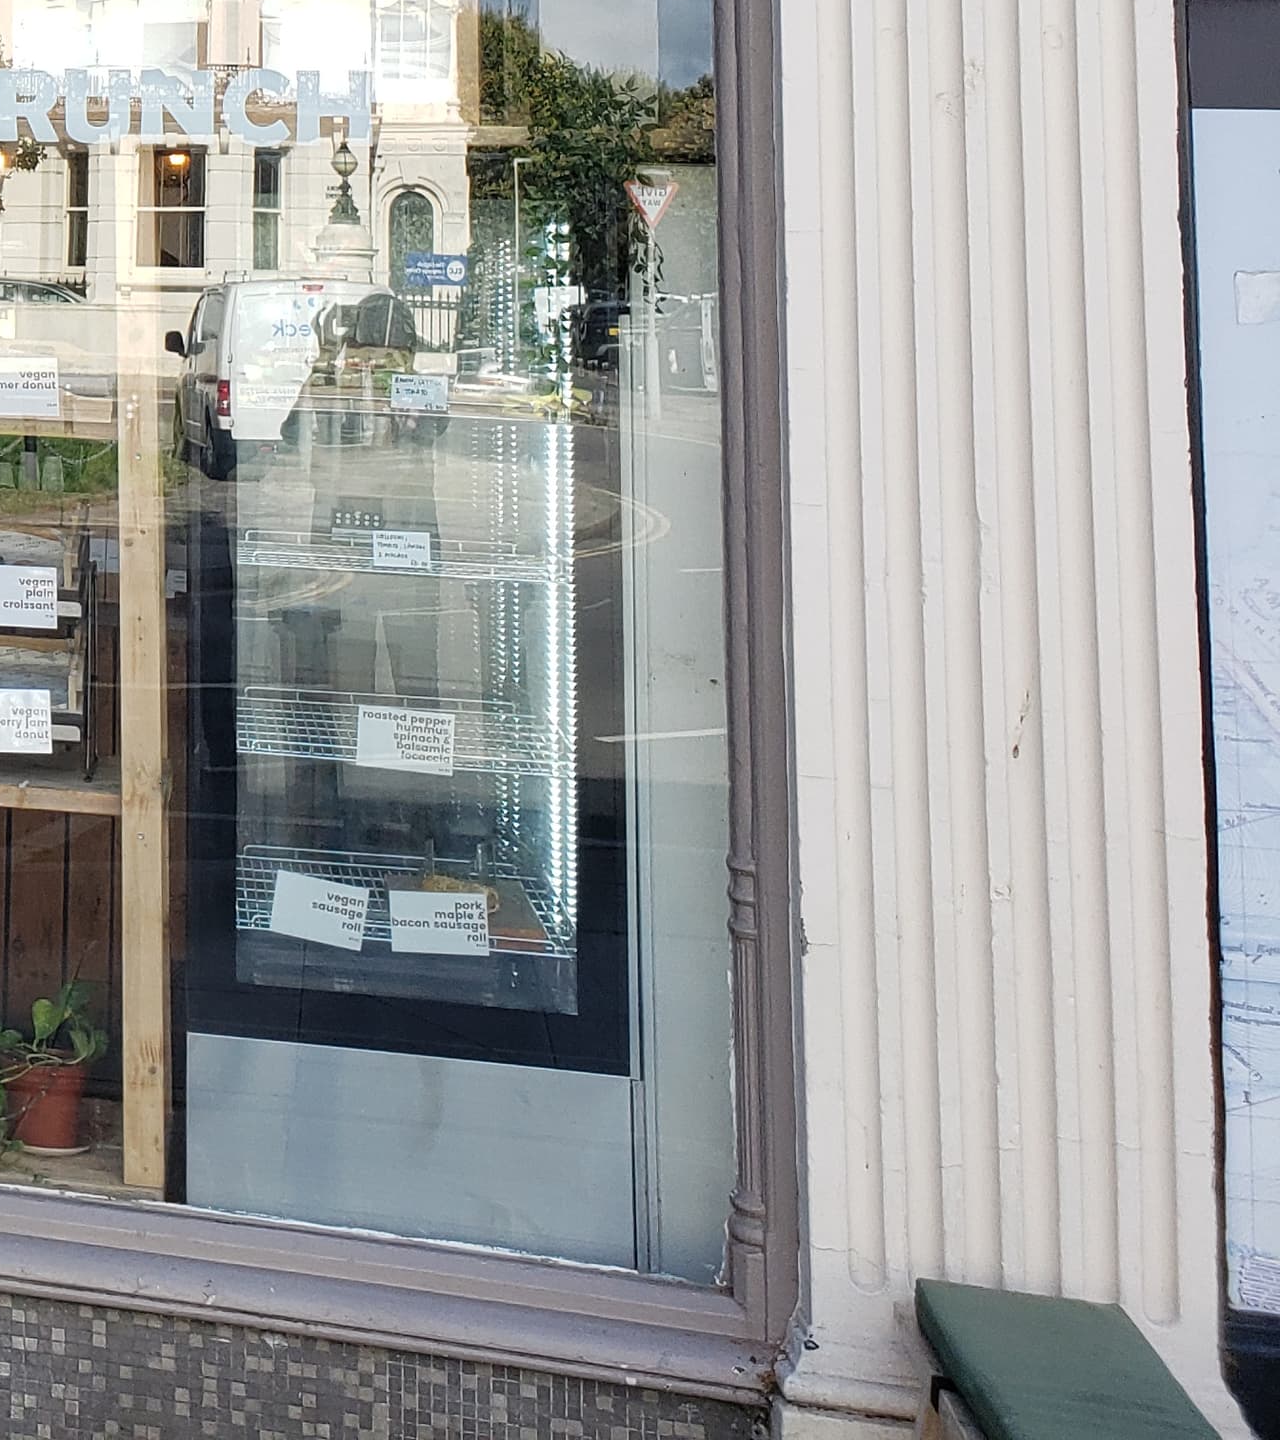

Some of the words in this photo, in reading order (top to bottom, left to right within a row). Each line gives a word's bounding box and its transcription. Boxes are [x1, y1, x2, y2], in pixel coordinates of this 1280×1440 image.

[19, 371, 55, 381] vegan
[22, 380, 56, 389] donut
[19, 578, 54, 588] vegan
[26, 587, 54, 599] plain
[3, 600, 54, 610] croissant
[11, 707, 48, 717] vegan
[25, 715, 48, 728] jam
[363, 711, 407, 721] roasted
[410, 715, 451, 727] pepper
[15, 730, 49, 739] donut
[394, 732, 440, 744] spinach
[443, 737, 450, 745] &
[396, 742, 451, 754] balsamic
[401, 750, 450, 763] focaccia
[327, 892, 365, 908] vegan
[312, 901, 363, 920] sausage
[435, 911, 474, 922] maple
[478, 911, 485, 920] &
[342, 922, 361, 933] roll
[392, 917, 430, 928] bacon
[433, 921, 486, 932] sausage
[467, 933, 487, 942] roll
